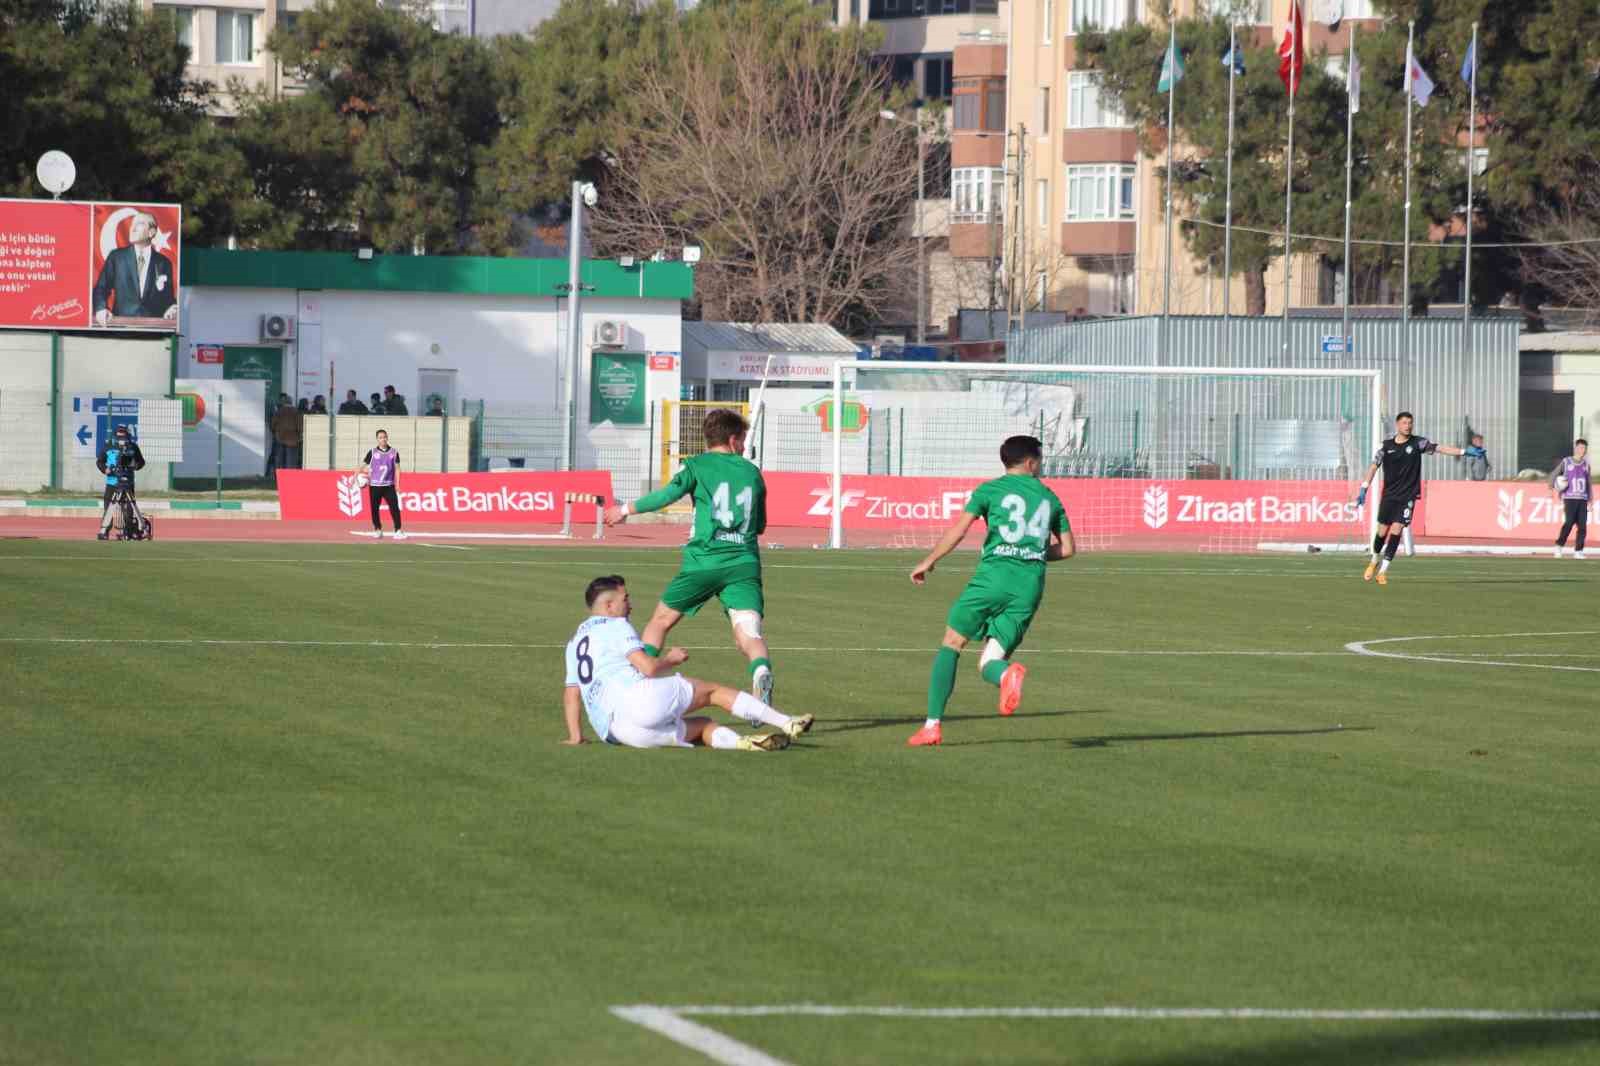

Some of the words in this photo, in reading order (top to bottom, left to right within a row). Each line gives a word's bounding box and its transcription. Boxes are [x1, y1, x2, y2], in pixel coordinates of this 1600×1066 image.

[9, 232, 26, 245] için
[28, 233, 56, 244] bütün
[10, 247, 22, 255] ve
[15, 258, 51, 270] kalpten
[7, 271, 25, 280] onu
[379, 466, 387, 482] 7
[1571, 478, 1585, 493] 10
[452, 486, 554, 513] Bankası
[712, 482, 753, 534] 41
[1176, 495, 1256, 523] Ziraat
[1261, 495, 1364, 523] Bankası
[998, 493, 1051, 549] 34
[576, 635, 594, 685] 8
